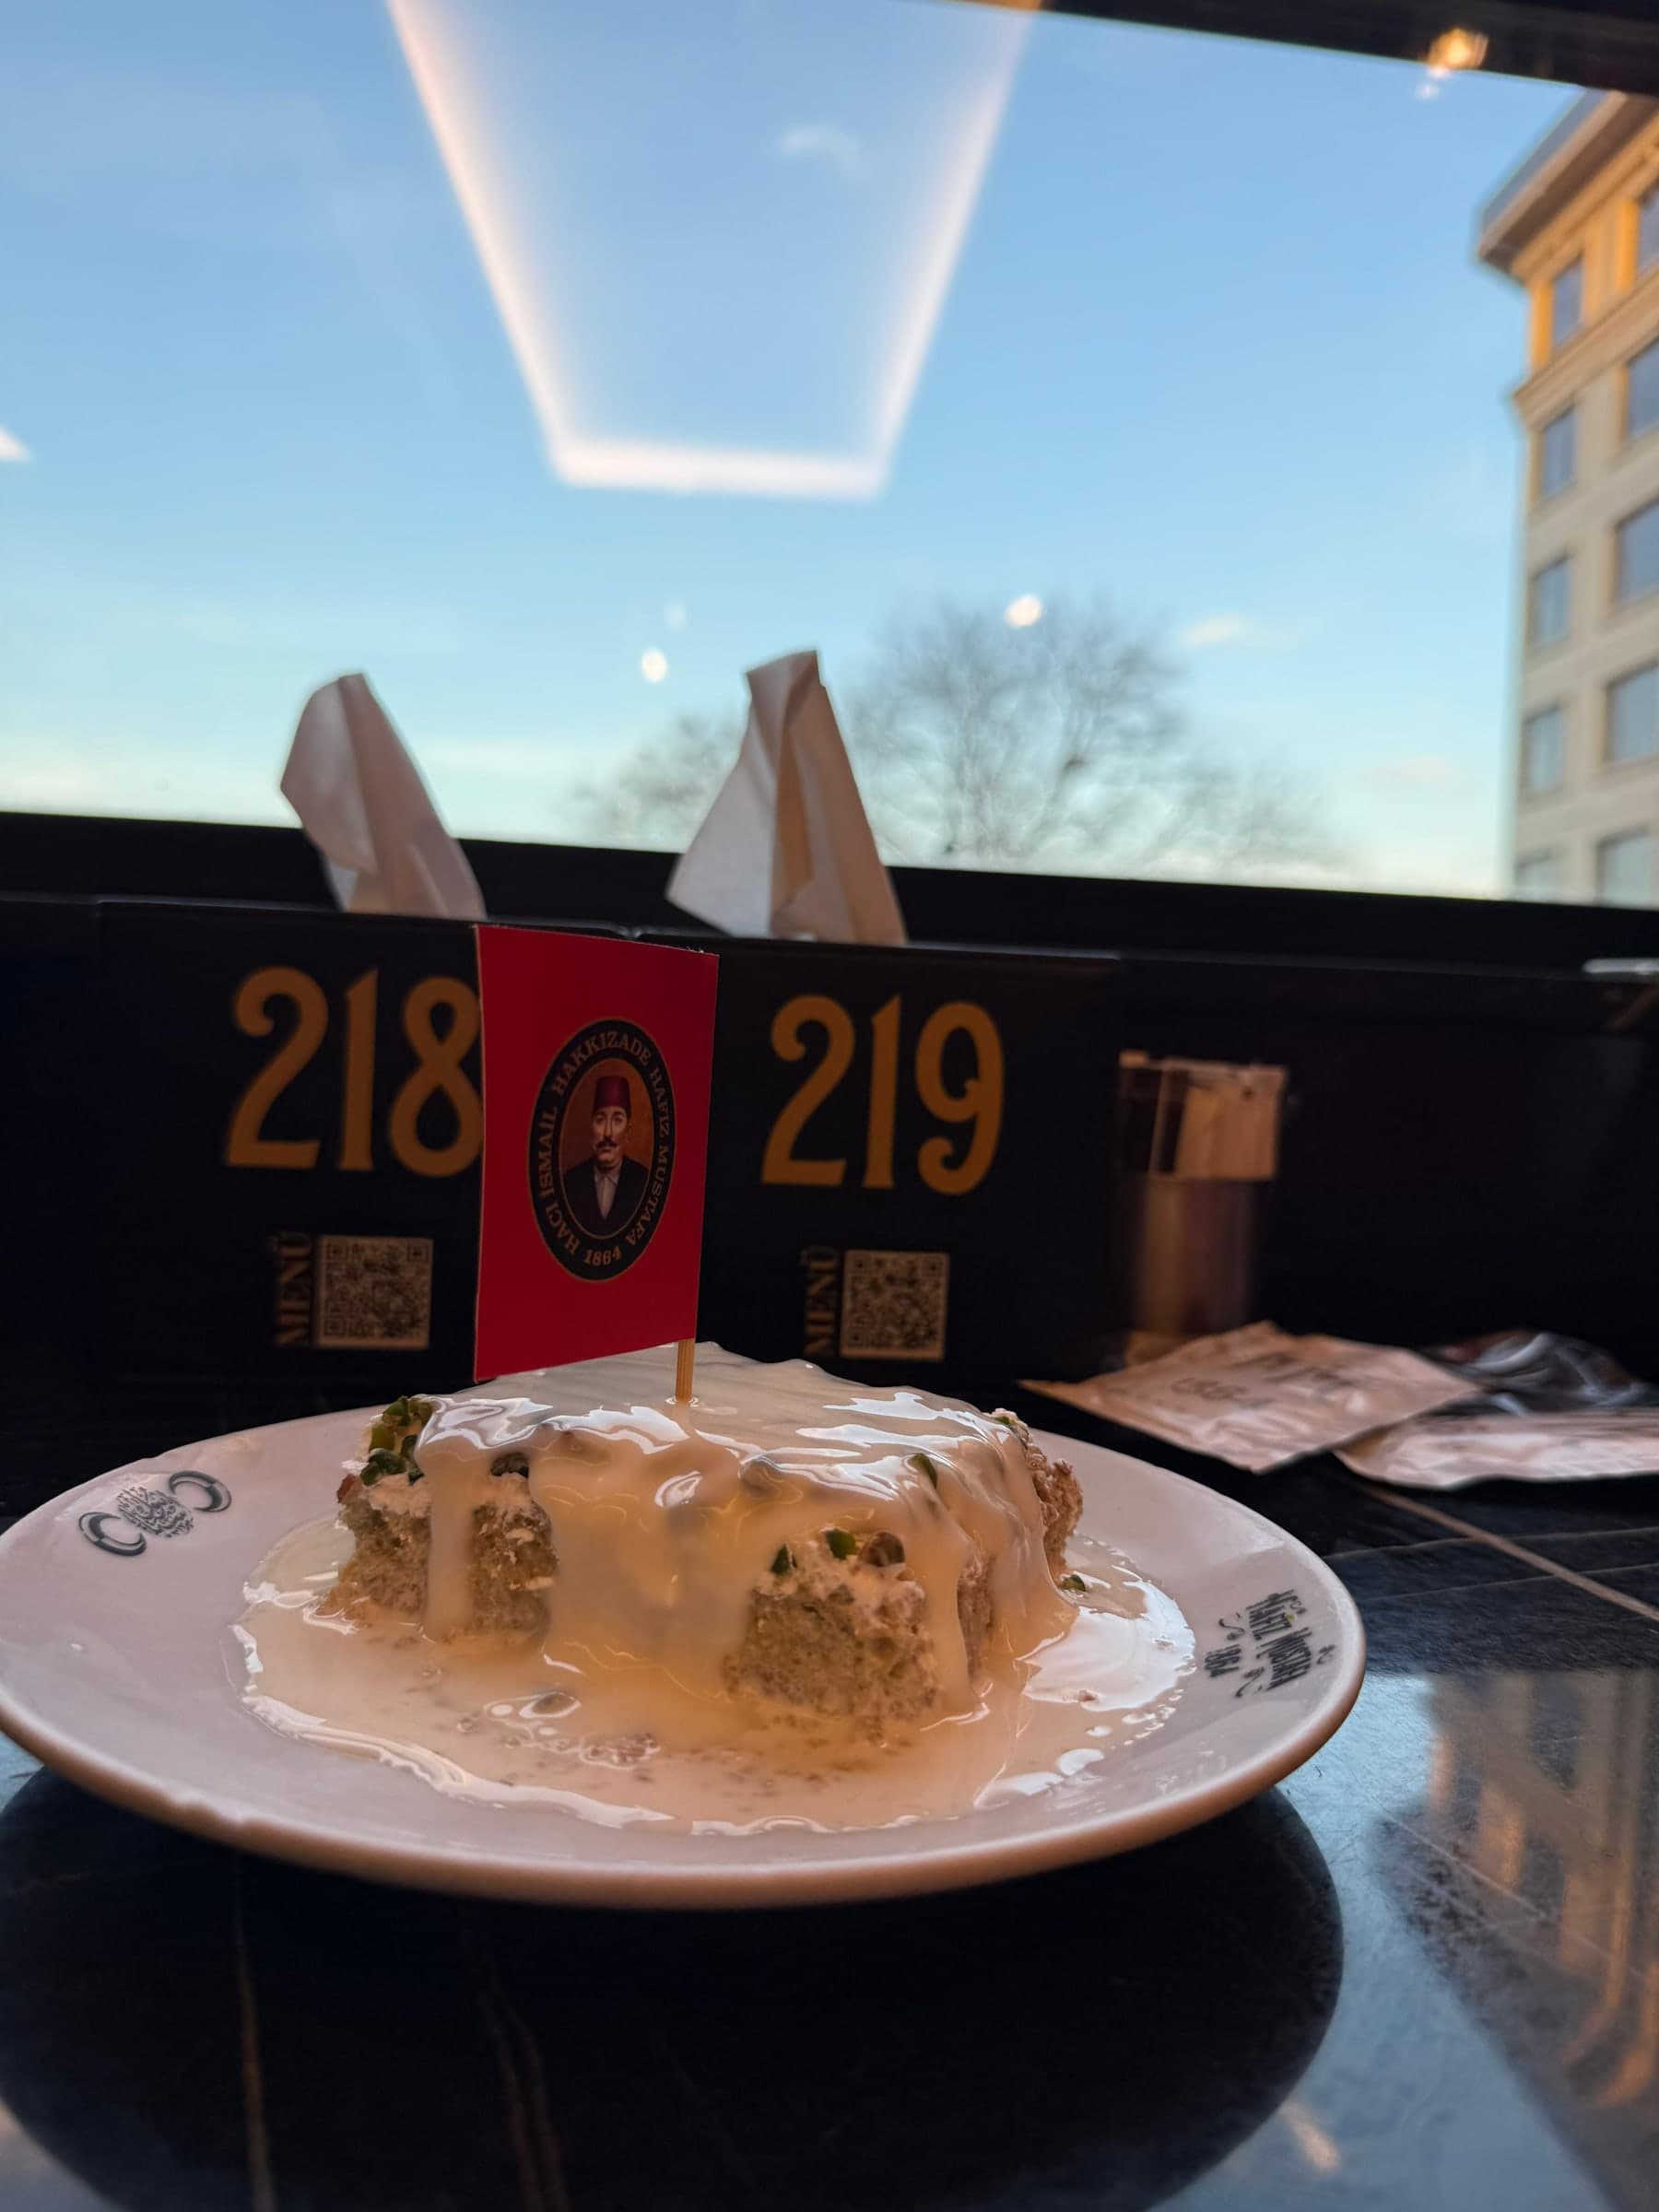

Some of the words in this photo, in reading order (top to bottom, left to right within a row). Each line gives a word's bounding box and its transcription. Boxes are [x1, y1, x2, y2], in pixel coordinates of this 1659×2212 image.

[226, 966, 484, 1178] 218
[551, 1030, 652, 1097] HAKKIZADE
[762, 993, 1005, 1195] 219
[649, 1065, 670, 1138] HAFIZ
[545, 1202, 581, 1254] HACI
[625, 1146, 669, 1246] MUSTAFA
[583, 1245, 622, 1266] 1864
